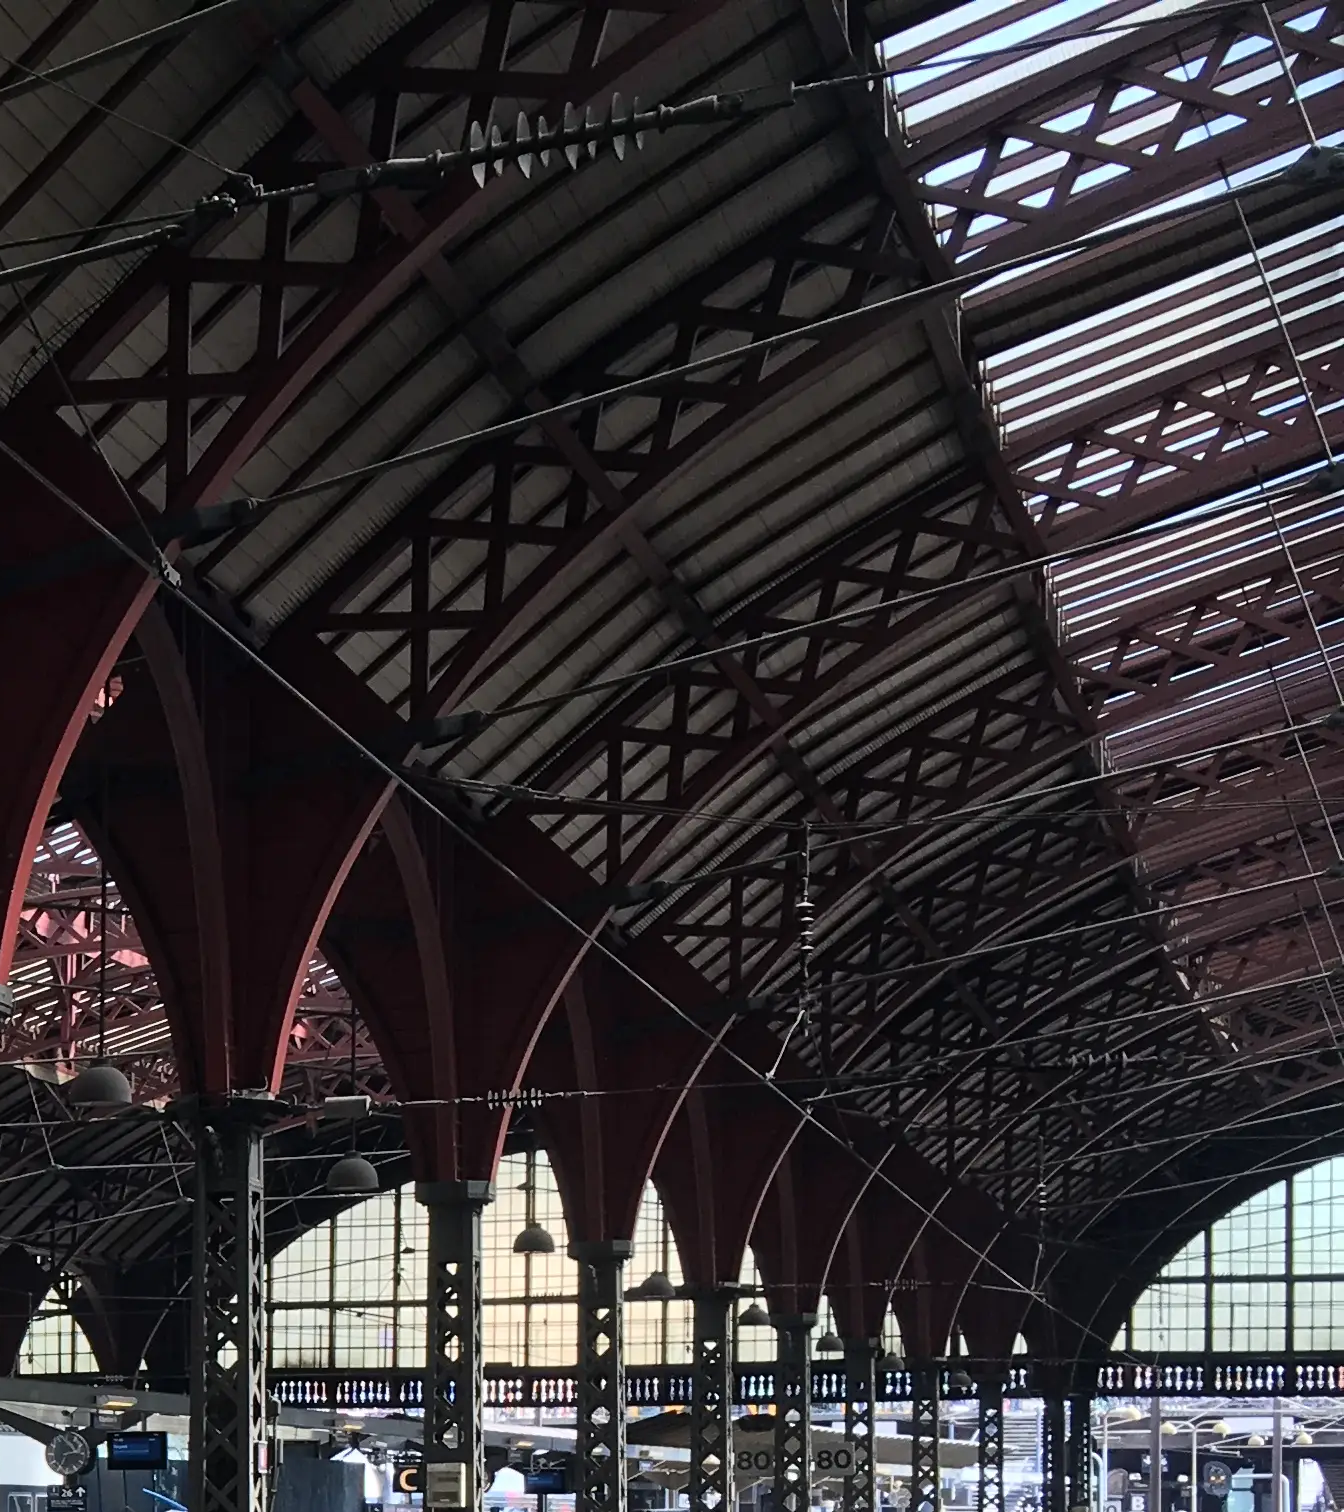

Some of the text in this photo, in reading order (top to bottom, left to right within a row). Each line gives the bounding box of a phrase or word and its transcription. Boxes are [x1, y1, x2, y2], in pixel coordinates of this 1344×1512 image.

[737, 1451, 770, 1470] 80
[817, 1449, 852, 1469] 80
[399, 1468, 418, 1492] C
[1131, 1496, 1145, 1511] B
